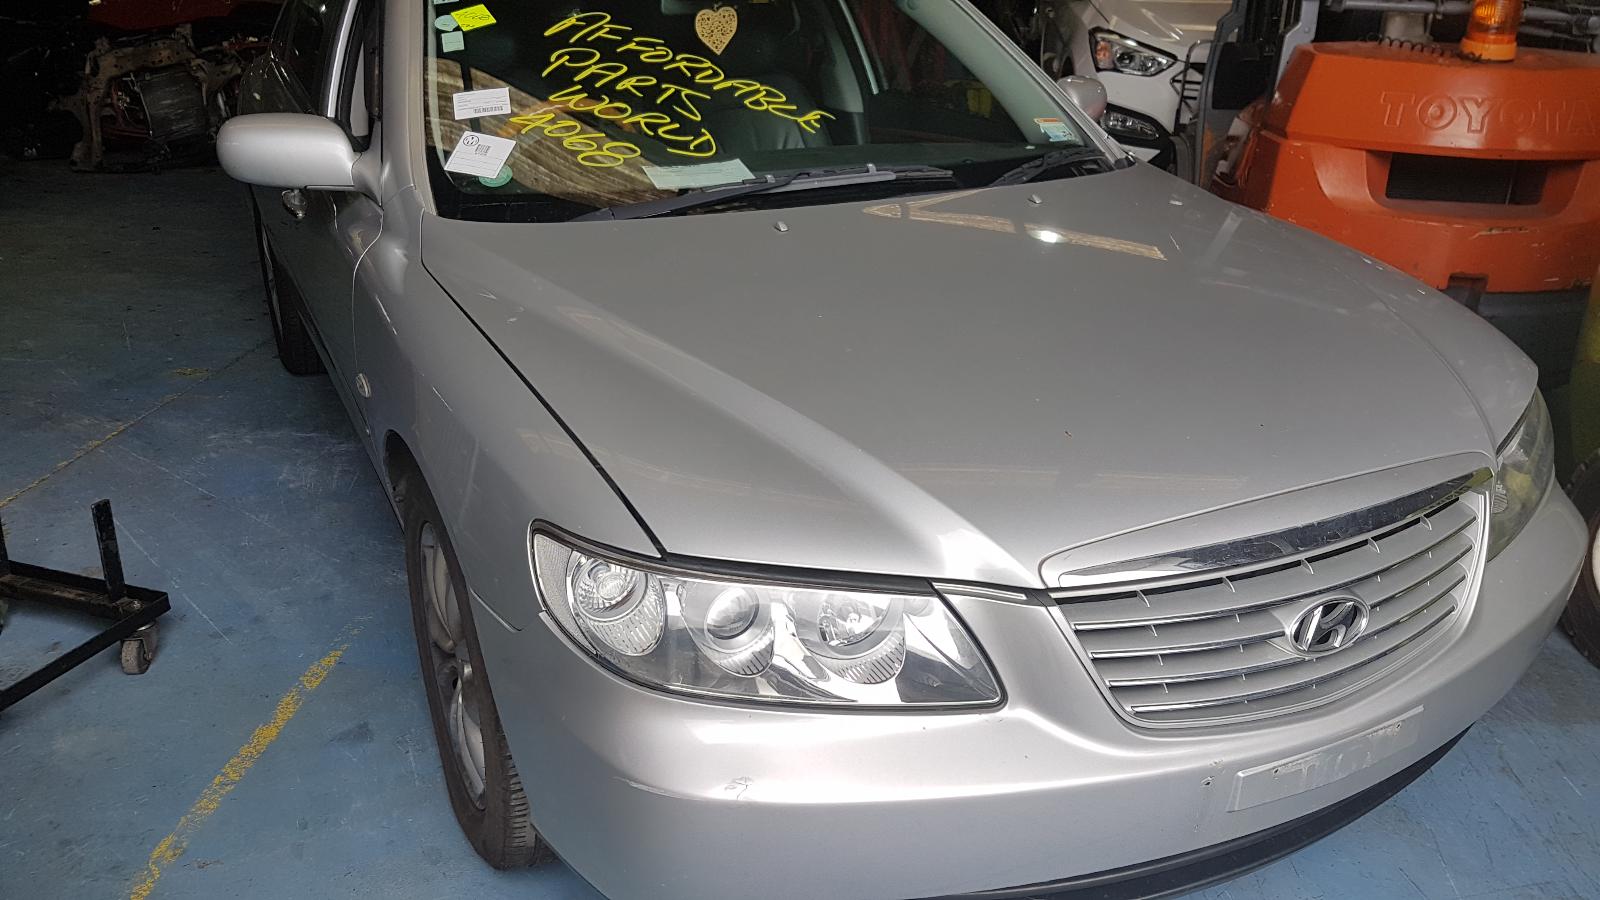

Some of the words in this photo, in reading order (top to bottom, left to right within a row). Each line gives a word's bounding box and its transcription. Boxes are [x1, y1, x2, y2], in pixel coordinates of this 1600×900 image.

[541, 47, 711, 122] PARTS
[543, 11, 837, 134] AFFORDABLE
[508, 112, 641, 168] 4068
[548, 84, 717, 157] WORLD
[1379, 91, 1597, 138] TOYOTA
